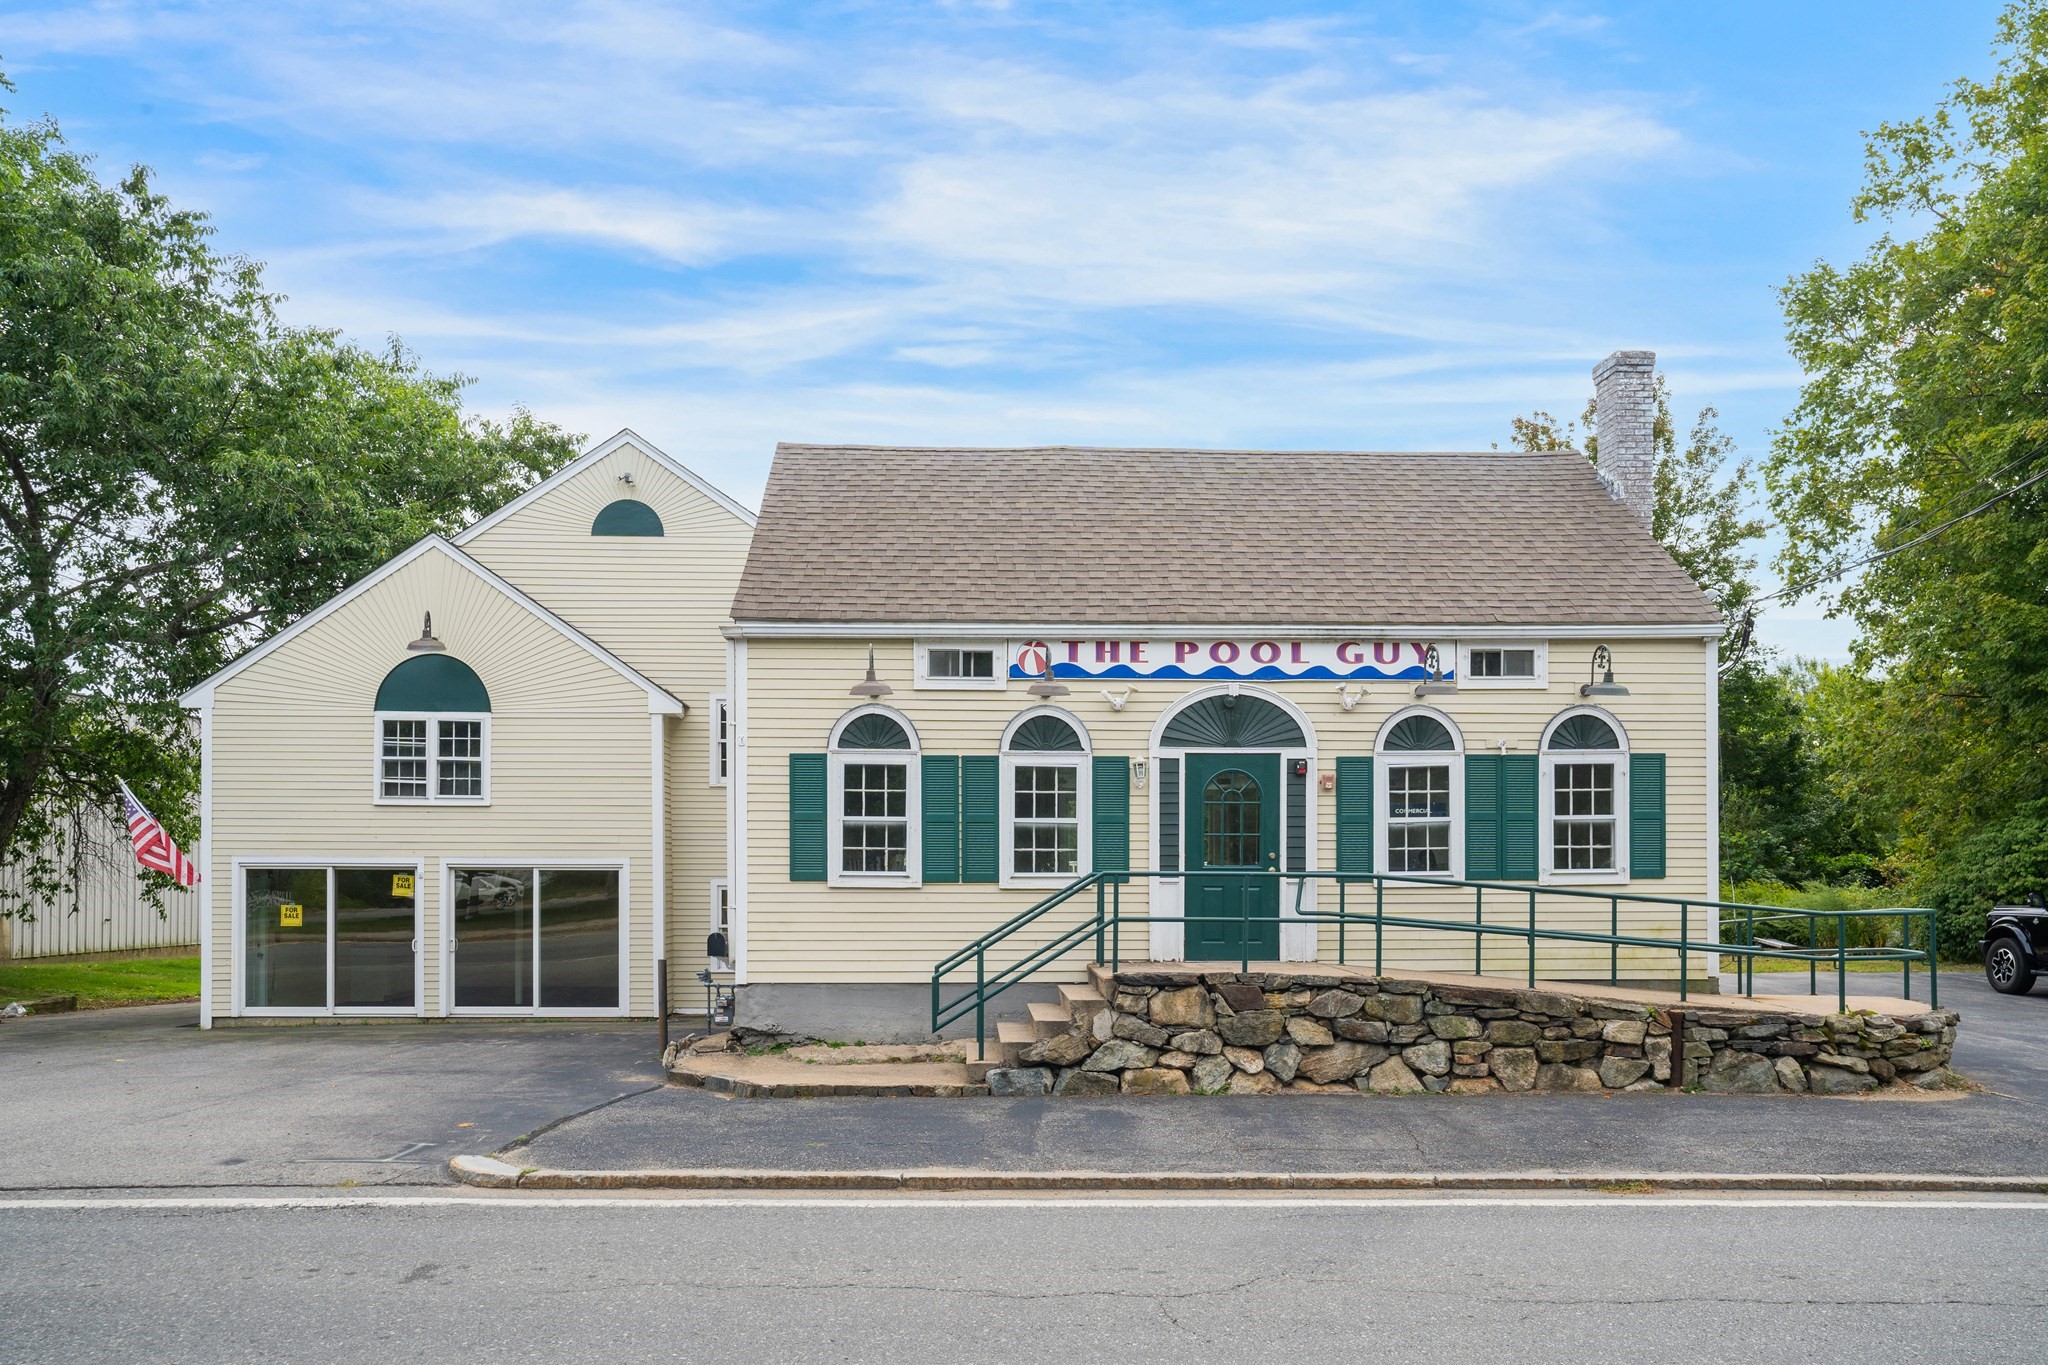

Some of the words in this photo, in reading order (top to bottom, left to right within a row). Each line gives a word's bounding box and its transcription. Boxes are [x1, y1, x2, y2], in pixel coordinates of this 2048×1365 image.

[1061, 640, 1149, 663] THE
[1175, 641, 1310, 664] POOL
[1336, 641, 1436, 665] GUY
